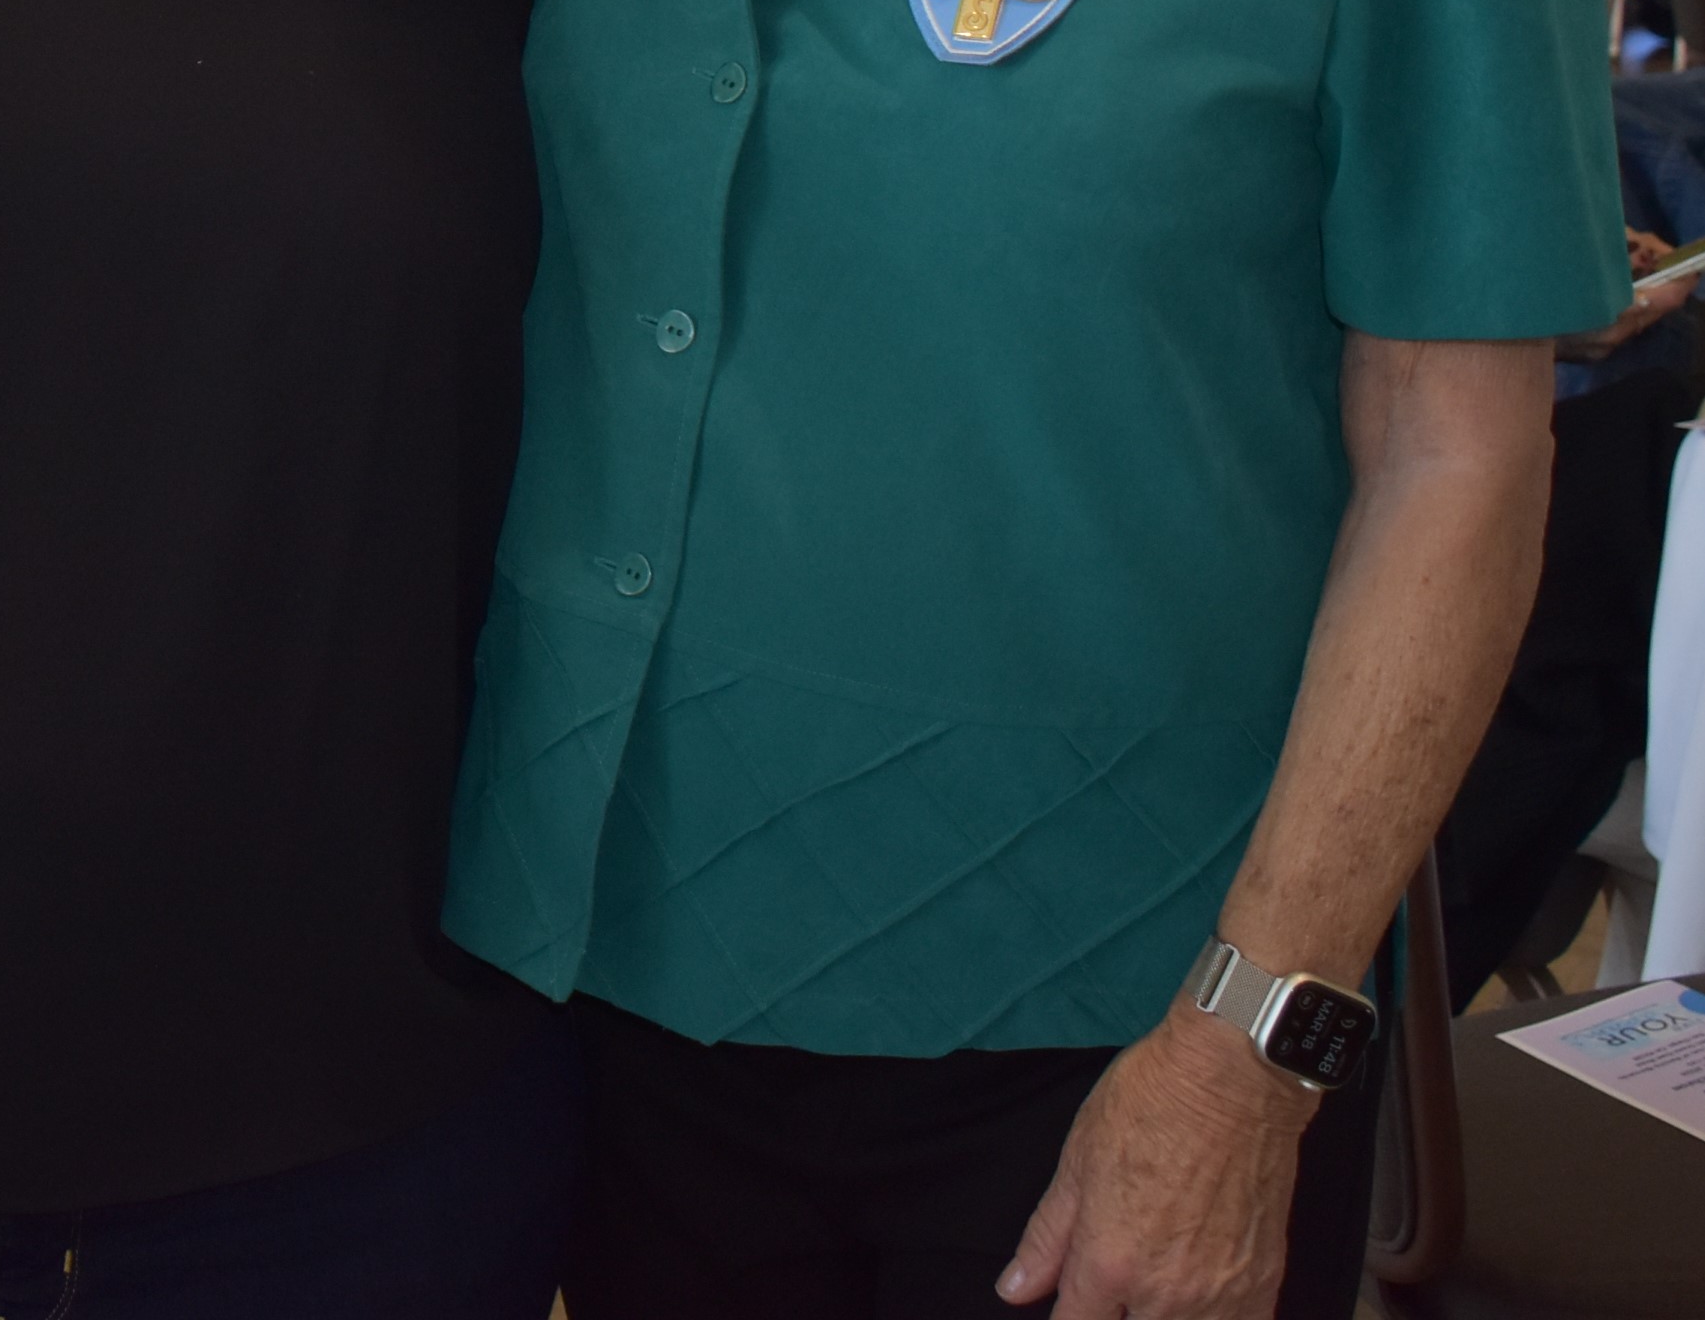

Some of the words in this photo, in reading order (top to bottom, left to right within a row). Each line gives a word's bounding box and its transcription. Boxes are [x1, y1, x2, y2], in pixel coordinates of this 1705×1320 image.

[1309, 999, 1334, 1032] MAR
[1598, 1013, 1688, 1046] YOUR
[1301, 1034, 1318, 1051] 18
[1318, 1034, 1345, 1074] 11:48
